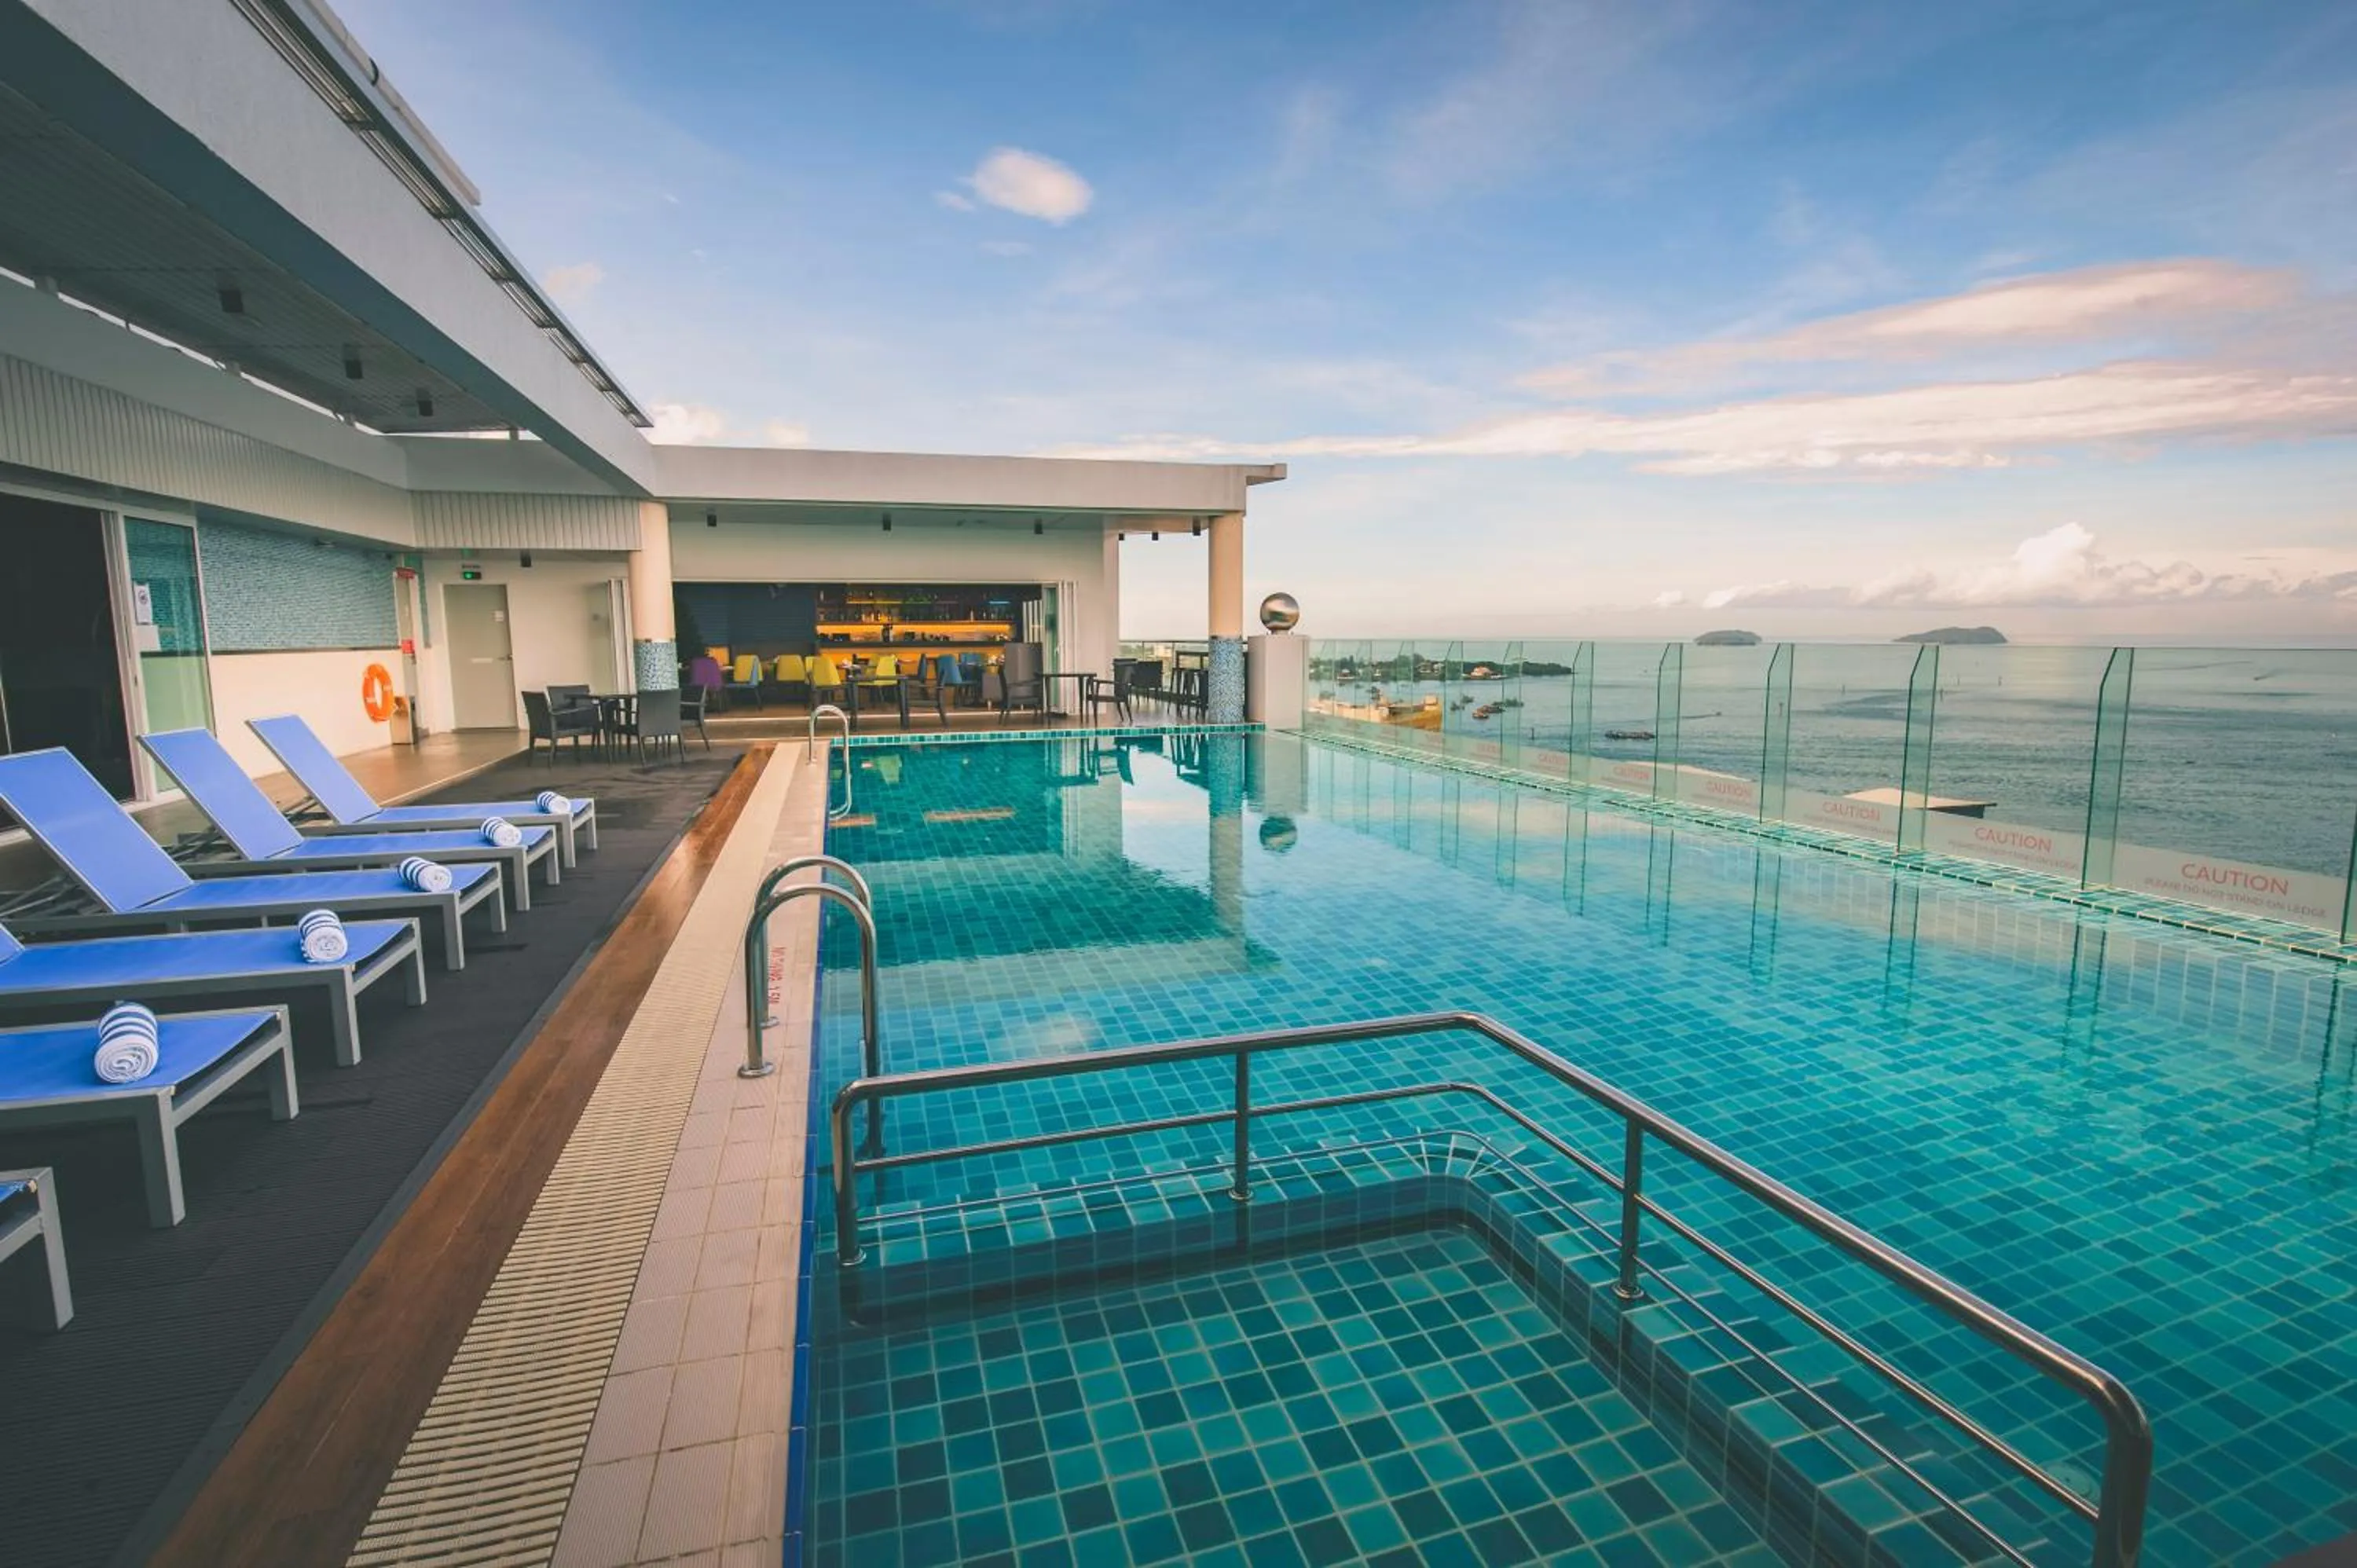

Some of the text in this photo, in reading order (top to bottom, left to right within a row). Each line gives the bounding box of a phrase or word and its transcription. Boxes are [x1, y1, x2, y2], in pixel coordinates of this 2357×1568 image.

[1822, 800, 1881, 821] CAUTION
[1974, 826, 2052, 853] CAUTION
[2181, 863, 2289, 896] CAUTION
